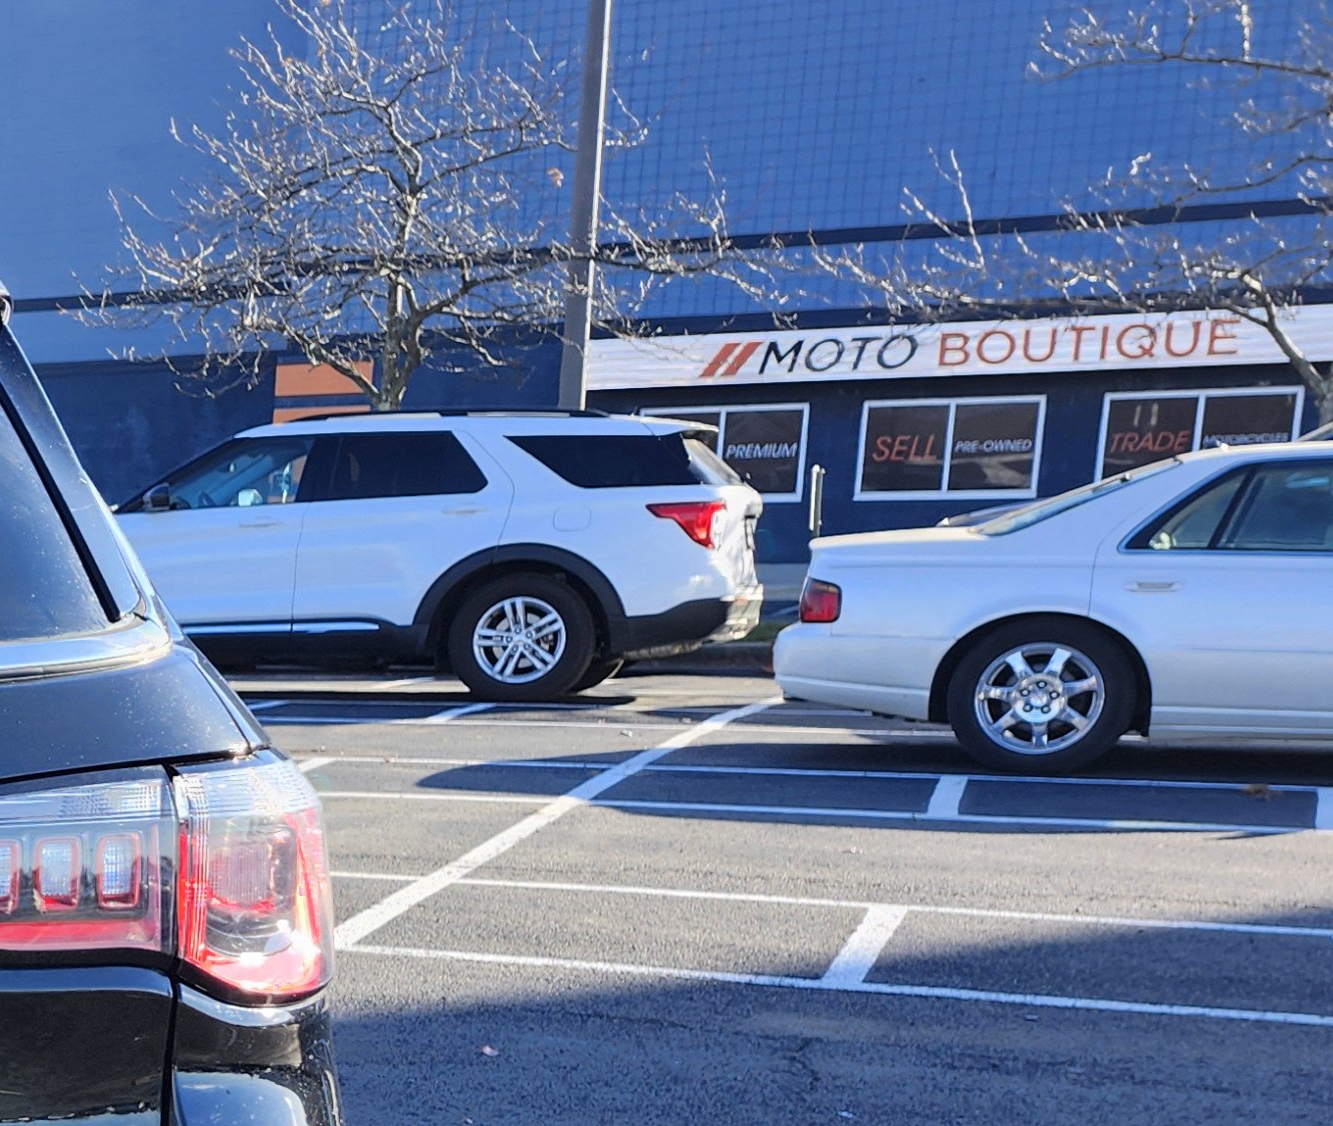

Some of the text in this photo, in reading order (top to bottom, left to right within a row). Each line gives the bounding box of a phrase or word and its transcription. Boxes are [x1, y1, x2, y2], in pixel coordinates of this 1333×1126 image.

[758, 318, 1242, 375] MOTO BOUTIQUE
[724, 441, 799, 460] PREMIUM
[872, 433, 1033, 463] SELL PRE-OWNED
[1110, 430, 1191, 454] TRADE
